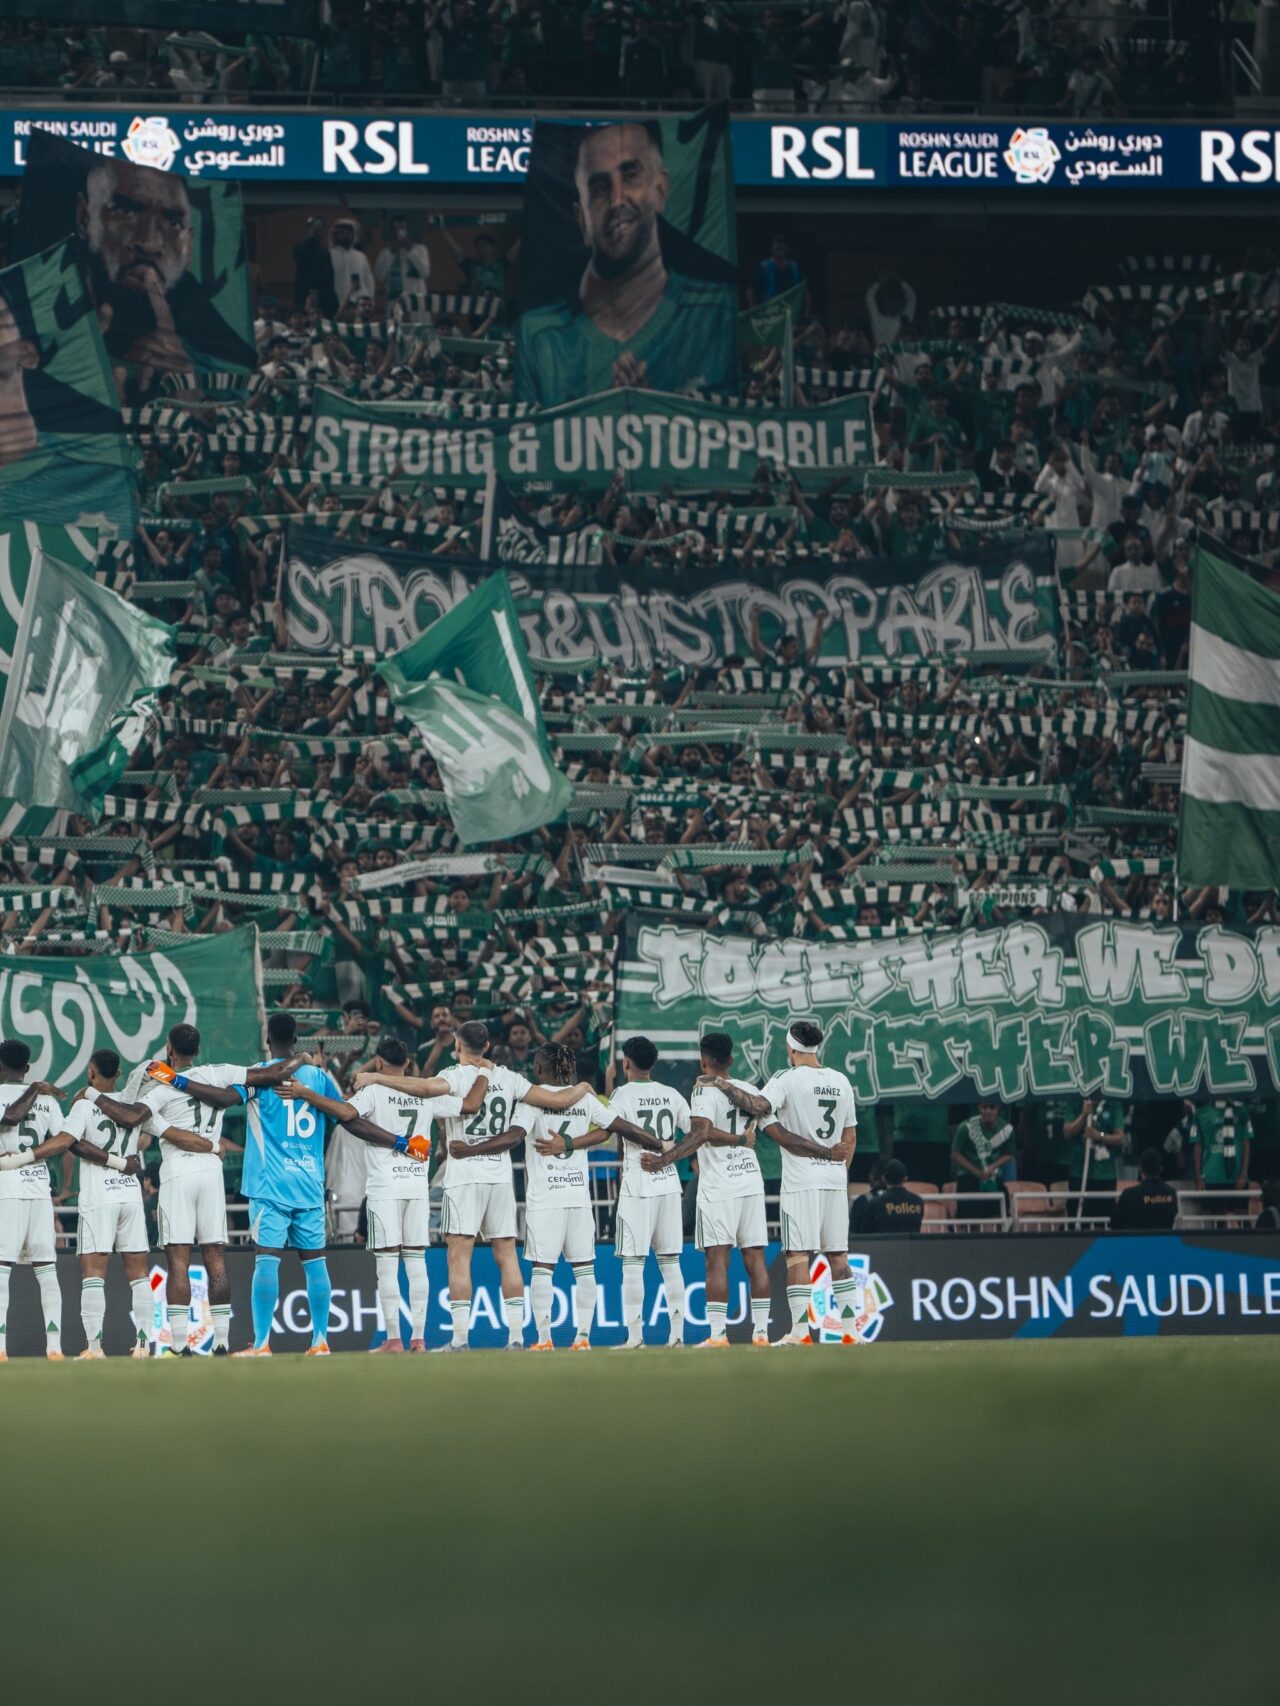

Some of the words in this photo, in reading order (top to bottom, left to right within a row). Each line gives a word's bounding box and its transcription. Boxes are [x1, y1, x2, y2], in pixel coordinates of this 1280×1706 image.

[70, 121, 117, 137] SAUDI
[184, 118, 236, 141] روشن
[238, 124, 285, 146] دوري
[467, 127, 520, 142] ROSHN
[899, 132, 951, 148] ROSHN
[953, 133, 999, 149] SAUDI
[1065, 128, 1116, 151] روشن
[184, 145, 285, 175] السعودي
[322, 120, 429, 174] RSL
[467, 146, 531, 173] LEAG
[771, 126, 875, 179] RSL
[1118, 134, 1163, 156] دوري
[1200, 130, 1280, 184] RS
[899, 151, 999, 178] LEAGUE
[1065, 155, 1163, 185] السعودي
[313, 415, 496, 475] STRONG
[507, 421, 540, 475] &
[553, 413, 868, 473] UNSTOPPABLE
[638, 921, 1066, 1013] TOGETHER
[1075, 920, 1190, 1006] WE
[1143, 1008, 1257, 1096] WE
[813, 1085, 841, 1097] IBAÑEZ
[283, 1098, 317, 1139] 16
[398, 1109, 418, 1142] 7
[465, 1096, 507, 1136] 28
[636, 1108, 674, 1142] 30
[816, 1099, 837, 1140] 3
[18, 1113, 40, 1153] 5
[554, 1120, 574, 1160] 6
[886, 1201, 921, 1216] Police
[1143, 1194, 1174, 1205] Police
[912, 1275, 1074, 1323] ROSHN
[1090, 1273, 1226, 1317] SAUDI
